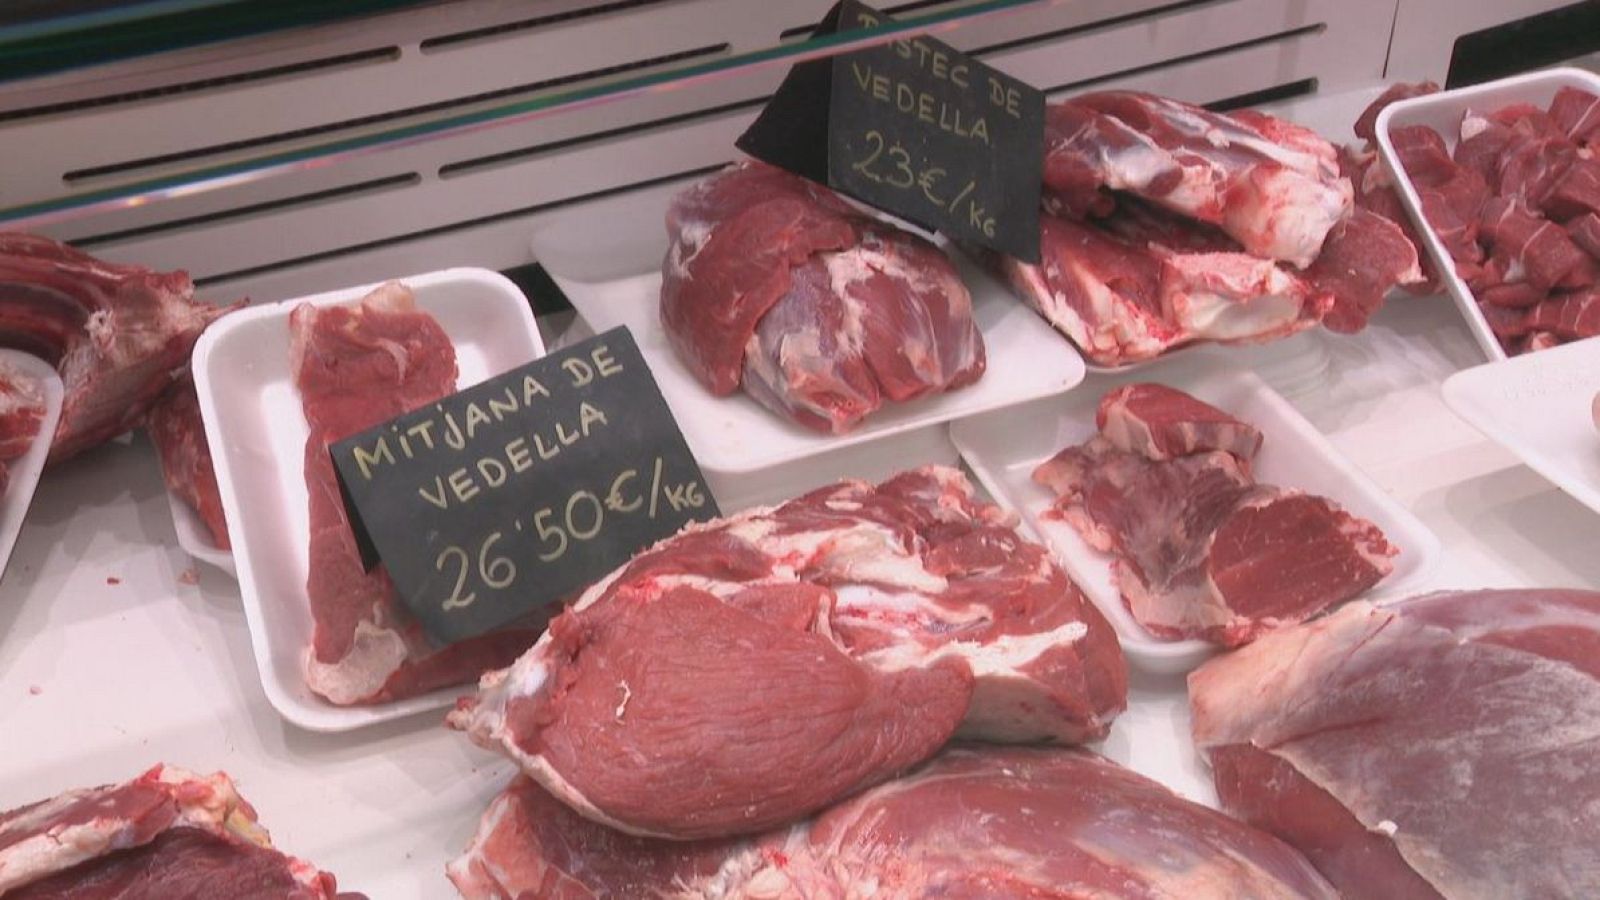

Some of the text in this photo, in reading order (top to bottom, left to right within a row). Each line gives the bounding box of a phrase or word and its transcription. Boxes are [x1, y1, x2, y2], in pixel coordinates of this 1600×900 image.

[852, 61, 990, 144] VEDELLA
[988, 77, 1022, 119] DE
[562, 345, 624, 389] DE
[418, 400, 608, 510] VEDELLA
